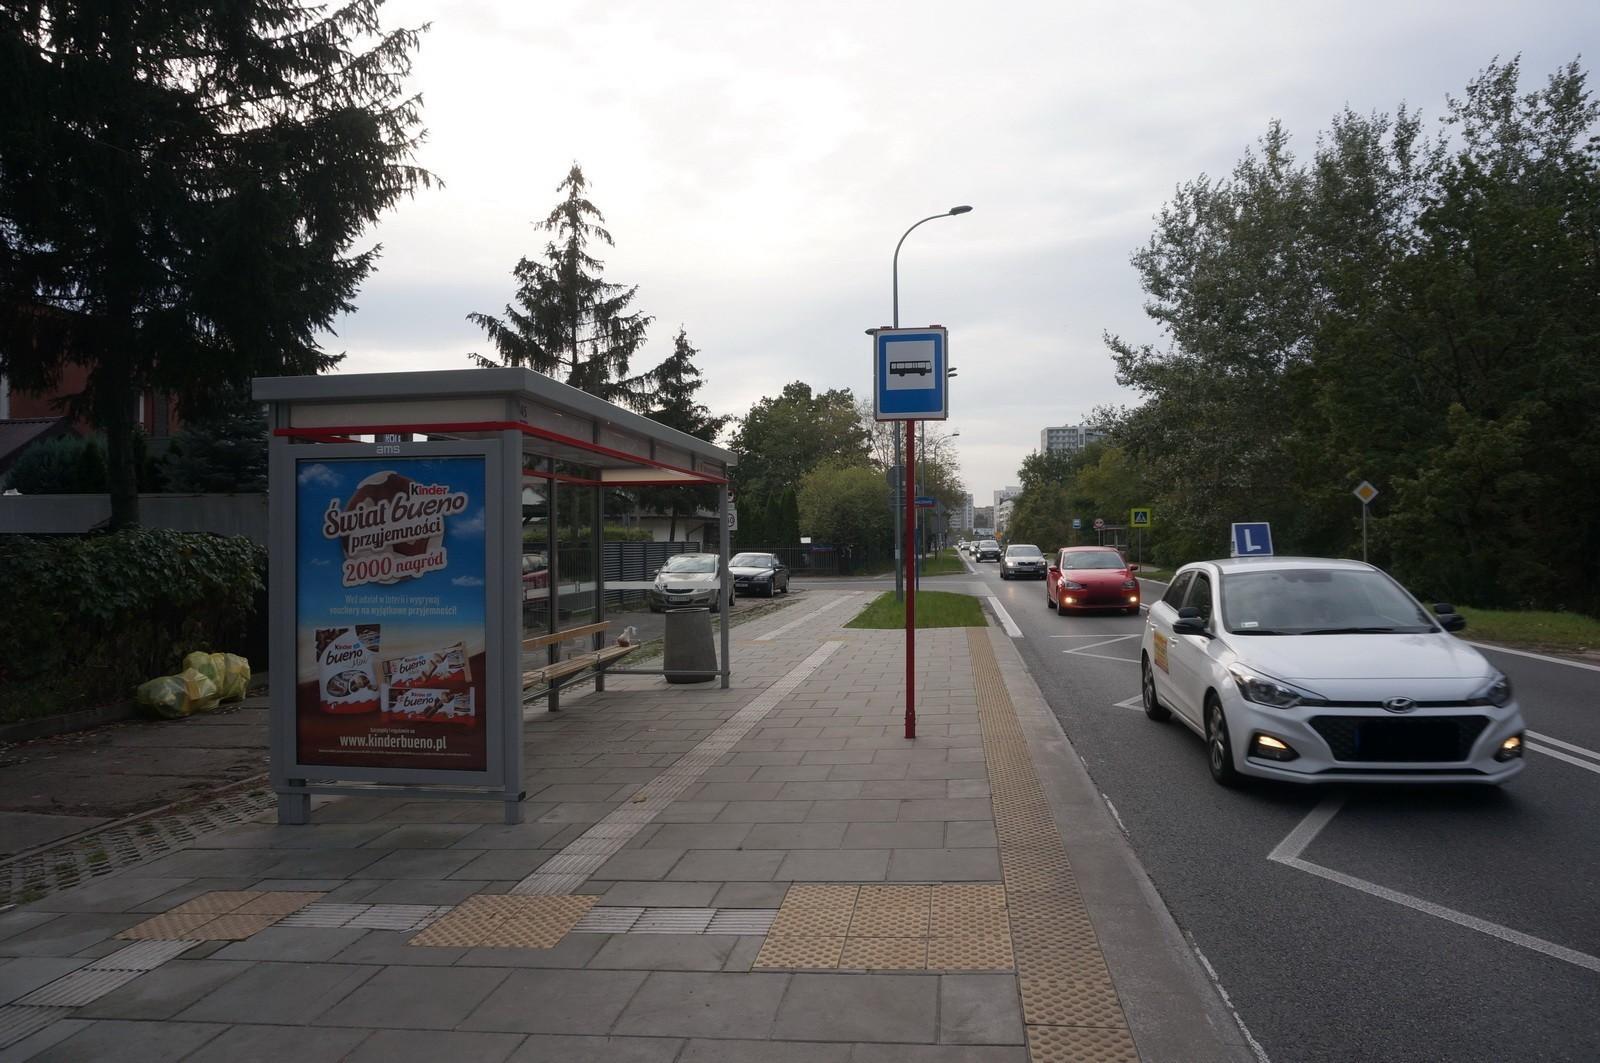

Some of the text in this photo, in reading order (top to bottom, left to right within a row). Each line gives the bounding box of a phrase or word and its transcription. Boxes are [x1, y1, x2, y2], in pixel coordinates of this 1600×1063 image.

[376, 445, 401, 454] ams
[325, 495, 465, 536] Świat bueno
[351, 517, 441, 552] przyjemności
[1244, 528, 1262, 552] L
[346, 551, 443, 582] 2000 nagród
[326, 648, 363, 666] bueno
[399, 659, 427, 674] bueno
[403, 695, 434, 708] bueno
[339, 733, 447, 751] www.kinderbueno.pl
